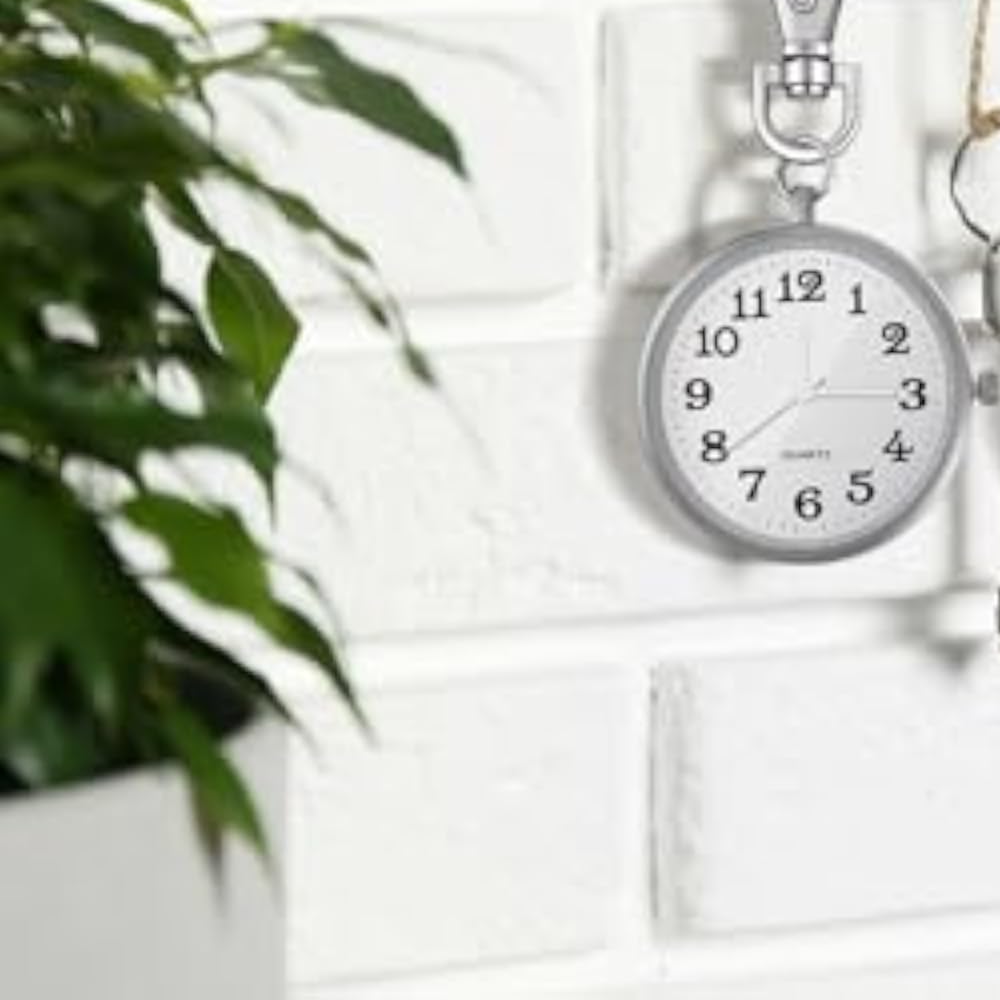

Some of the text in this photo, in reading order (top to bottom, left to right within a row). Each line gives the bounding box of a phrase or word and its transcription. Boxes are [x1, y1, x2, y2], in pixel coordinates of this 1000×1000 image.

[777, 270, 826, 303] 12
[849, 283, 867, 315] 1
[733, 287, 770, 320] 11
[696, 325, 740, 358] 10
[881, 322, 910, 355] 2
[684, 378, 713, 410] 9
[898, 377, 927, 411] 3
[700, 430, 729, 463] 8
[882, 429, 915, 463] 4
[737, 468, 767, 502] 7
[845, 470, 875, 506] 5
[794, 486, 823, 521] 6
